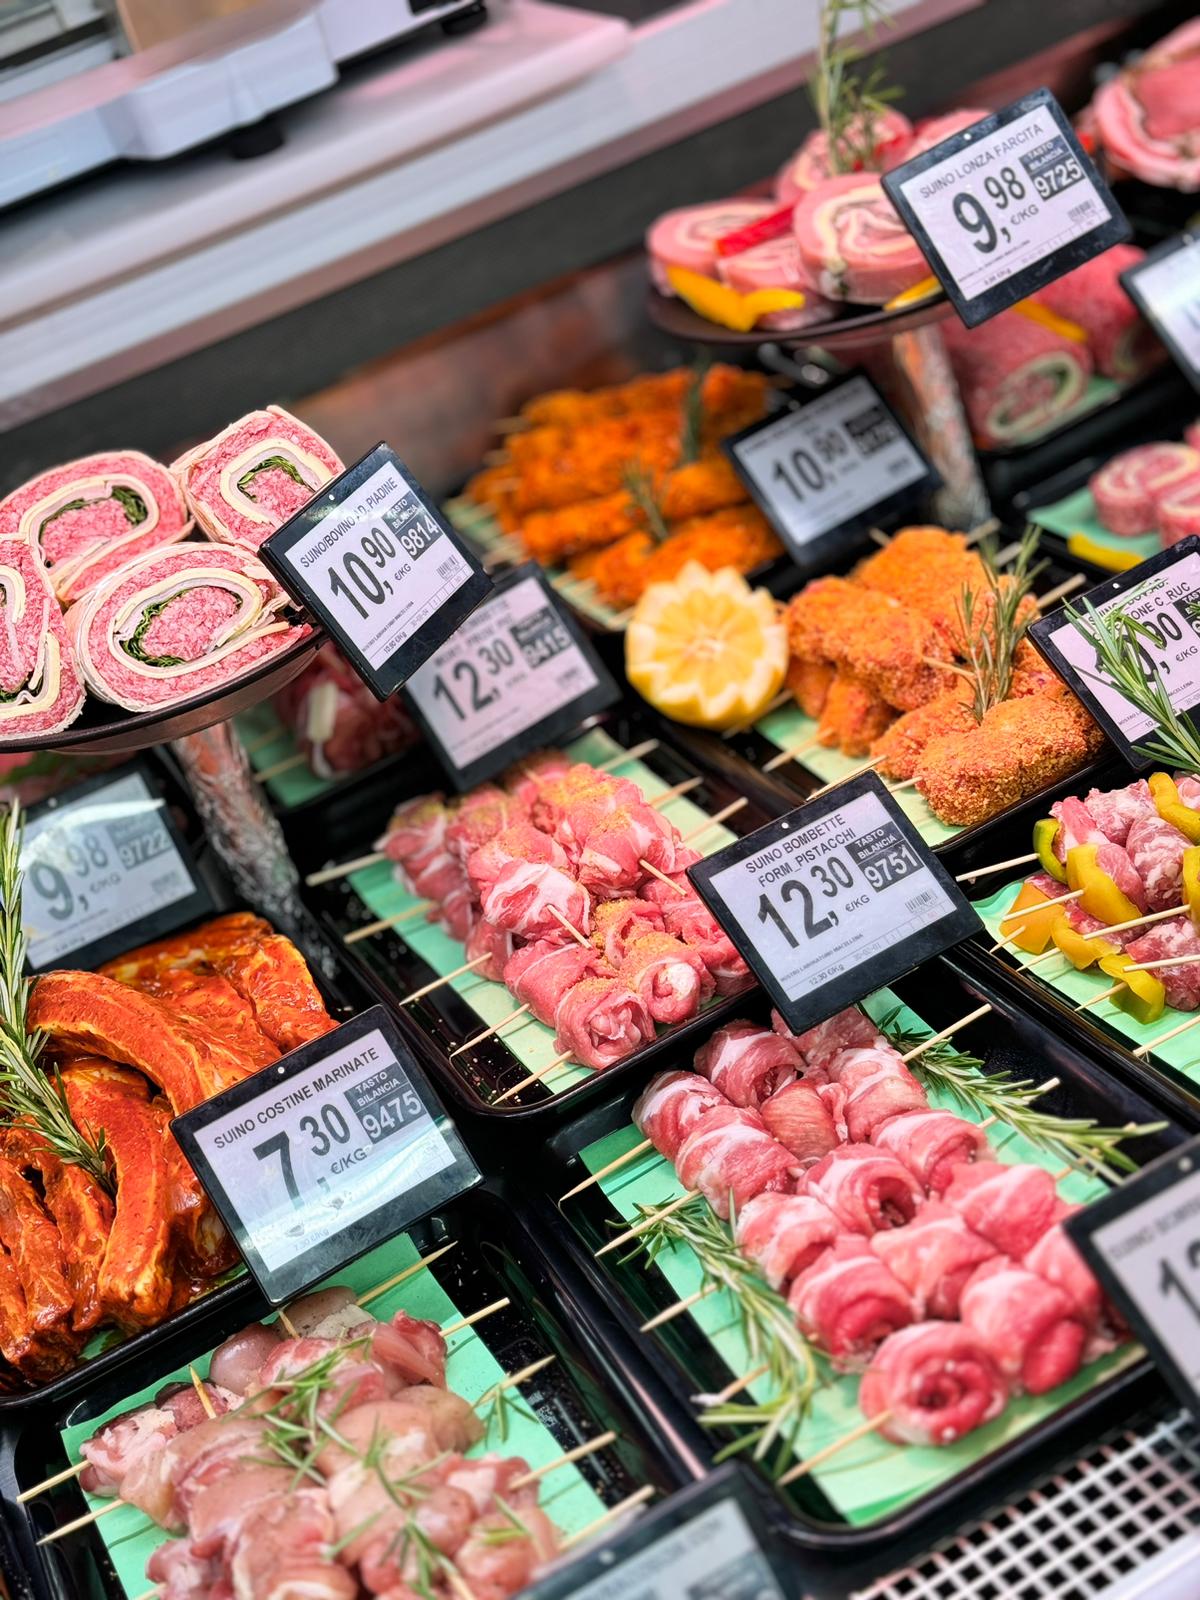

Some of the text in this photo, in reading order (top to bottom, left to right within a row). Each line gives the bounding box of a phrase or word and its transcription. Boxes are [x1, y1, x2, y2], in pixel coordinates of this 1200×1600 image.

[920, 123, 1044, 199] SUINO LONZA FARCITA
[1034, 157, 1083, 198] 9725
[1010, 204, 1040, 226] €/KG
[300, 515, 356, 568] SUINO/BOVINO
[365, 477, 398, 509] PIADINE
[400, 514, 439, 556] 9814
[394, 564, 412, 581] €/KG
[1175, 646, 1198, 662] €/KG
[745, 814, 846, 874] SUINO BOMBETTE
[854, 829, 885, 848] TASTO
[858, 834, 897, 860] BILANCIA
[758, 829, 857, 888] FORM_PISTACCHI
[863, 844, 918, 888] 9751
[845, 894, 871, 913] €/KG
[213, 1047, 380, 1149] SUINO COSTINE MARINATE
[354, 1072, 388, 1094] TASTO
[357, 1077, 400, 1107] BILANCIA
[362, 1089, 422, 1140] 9475
[330, 1148, 368, 1175] €/KG
